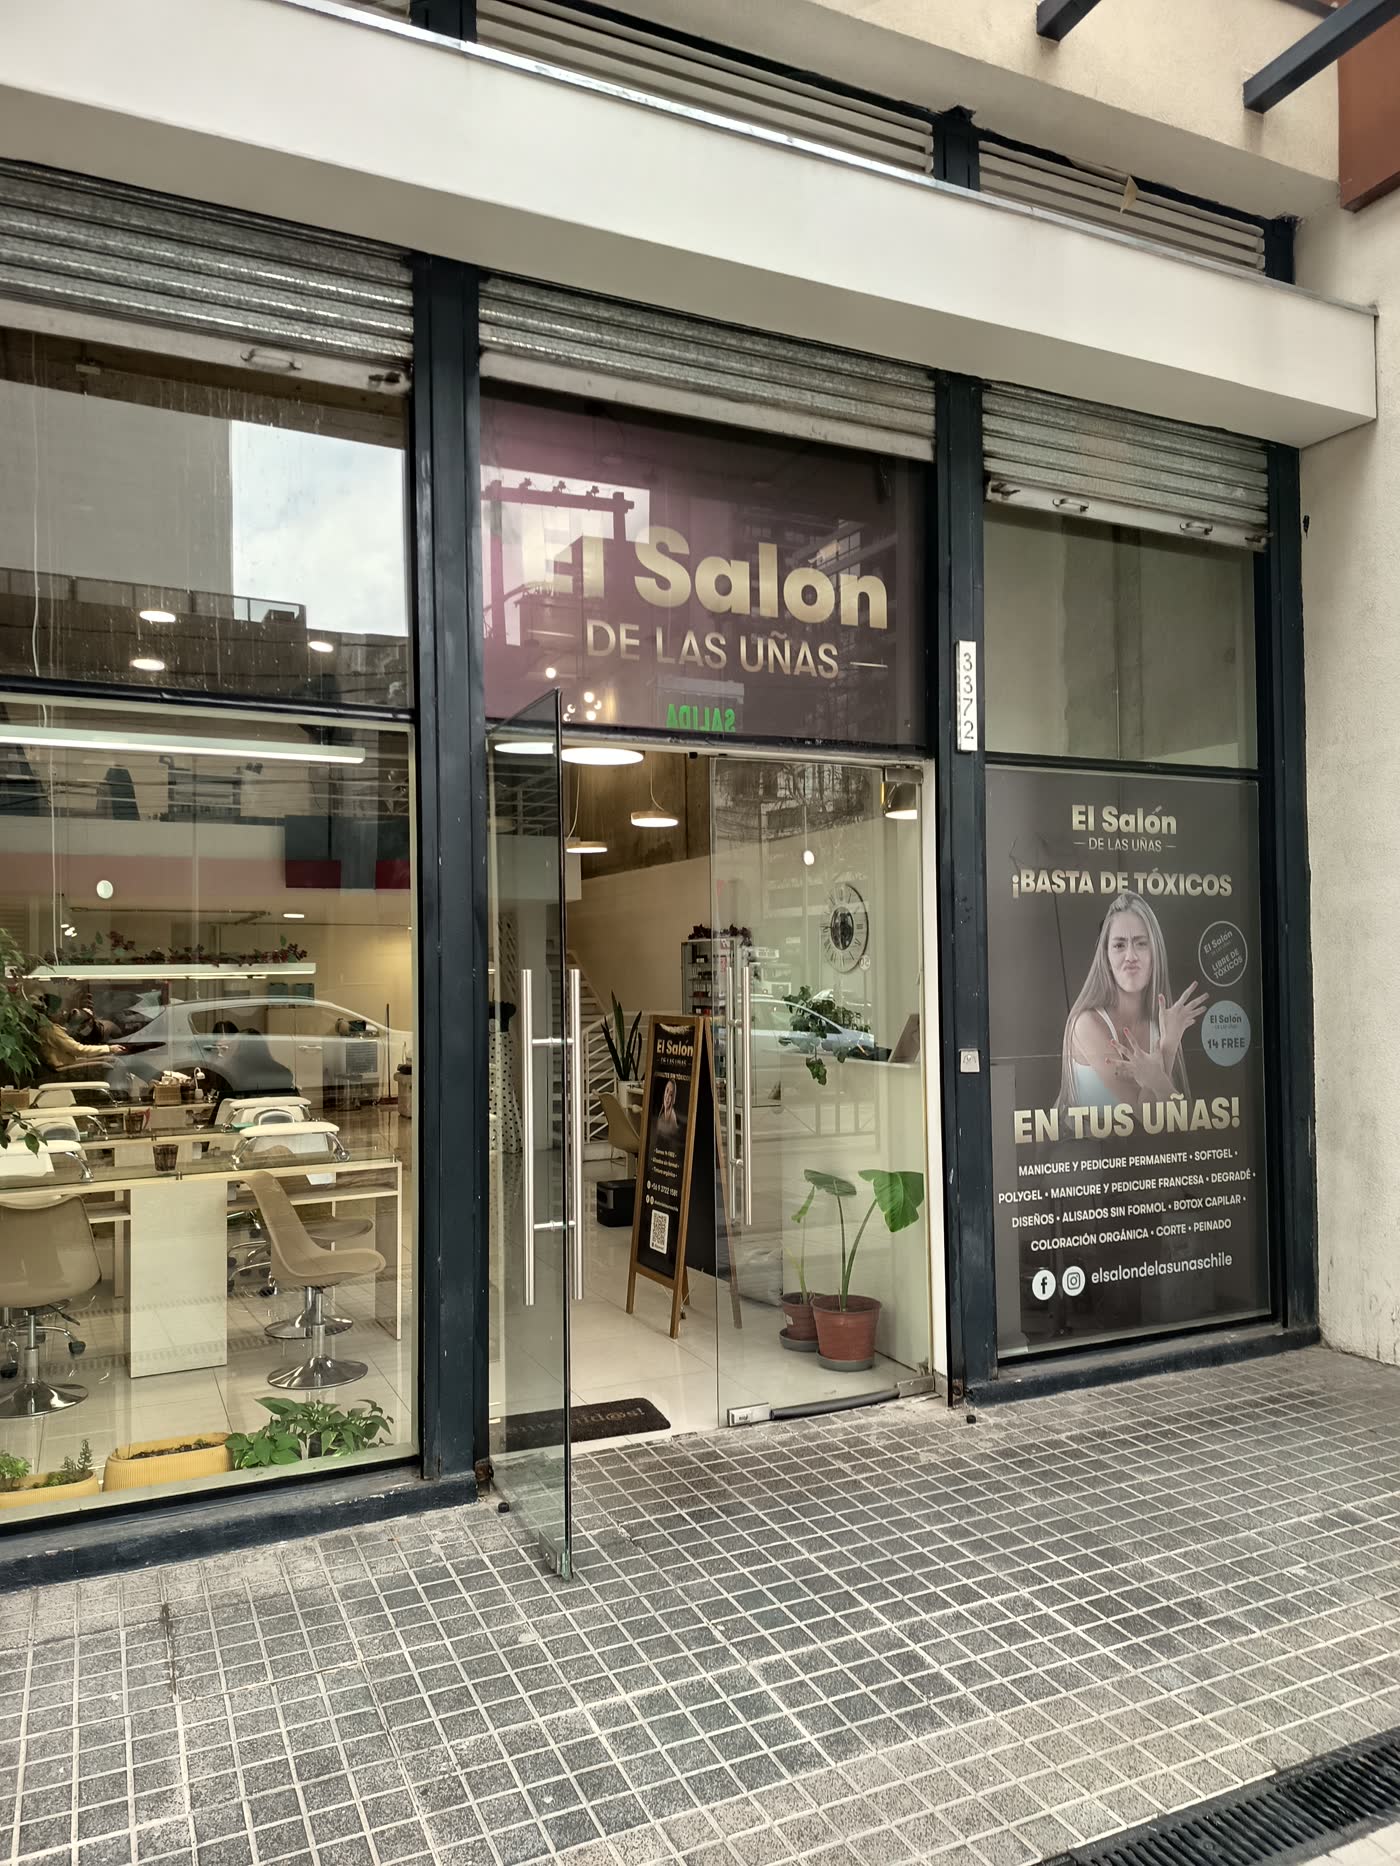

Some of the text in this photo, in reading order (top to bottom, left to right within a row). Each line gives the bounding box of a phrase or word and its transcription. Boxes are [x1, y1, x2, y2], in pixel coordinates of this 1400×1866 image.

[587, 619, 839, 680] DE LAS UÑAS
[962, 652, 975, 740] 3372
[1071, 804, 1177, 835] El Salón
[1089, 836, 1162, 853] DE LAS UÑAS
[1012, 867, 1233, 899] ¡BASTA DE TÓXICOS
[1211, 954, 1231, 972] LIBRE
[1230, 948, 1240, 959] DE
[1210, 1015, 1217, 1024] El
[656, 1039, 665, 1054] El
[1207, 1037, 1246, 1049] 14 FREE
[1014, 1092, 1241, 1144] EN TUS UÑAS!
[1018, 1148, 1233, 1177] MANICURE Y PEDICURE PERMANENTE SOFTGEL
[998, 1167, 1251, 1205] POLYGEL MANICURE Y PEDICURE FRANCESA DEGRADÉ
[1011, 1194, 1242, 1228] DISEÑOS ALISADOS SIN FORMOL BOTOX CAPILAR
[1030, 1218, 1232, 1252] COLORACIÓN ORGÁNICA CORTE PEINADO
[1091, 1252, 1233, 1284] elsalondelasunaschile
